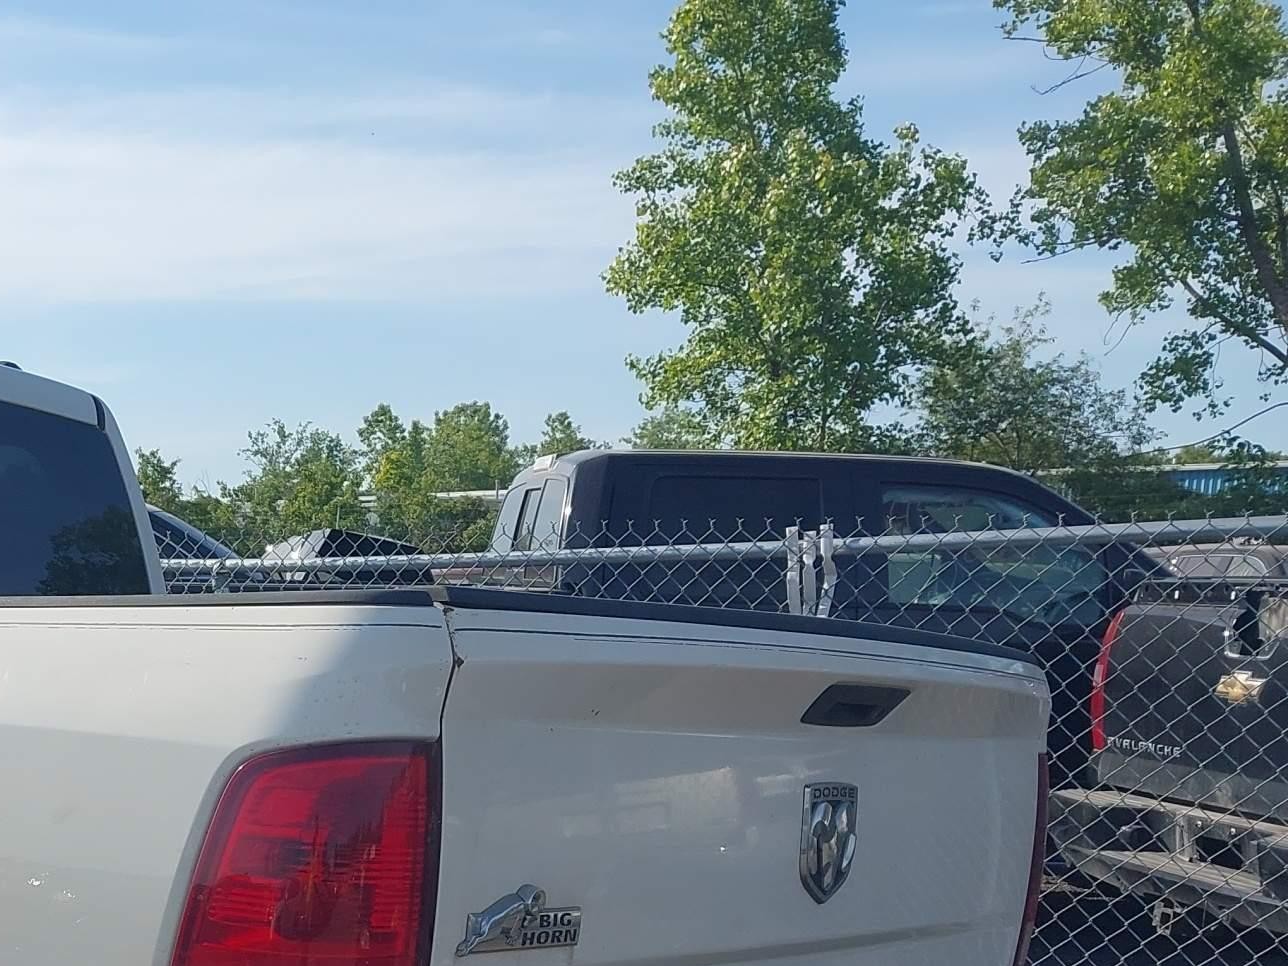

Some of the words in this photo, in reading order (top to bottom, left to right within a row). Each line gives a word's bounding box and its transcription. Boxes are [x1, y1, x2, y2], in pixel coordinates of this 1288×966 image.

[1107, 736, 1181, 758] AVALANCHE
[813, 787, 855, 799] DODGE
[539, 913, 572, 928] BIG
[521, 929, 578, 946] HORN
